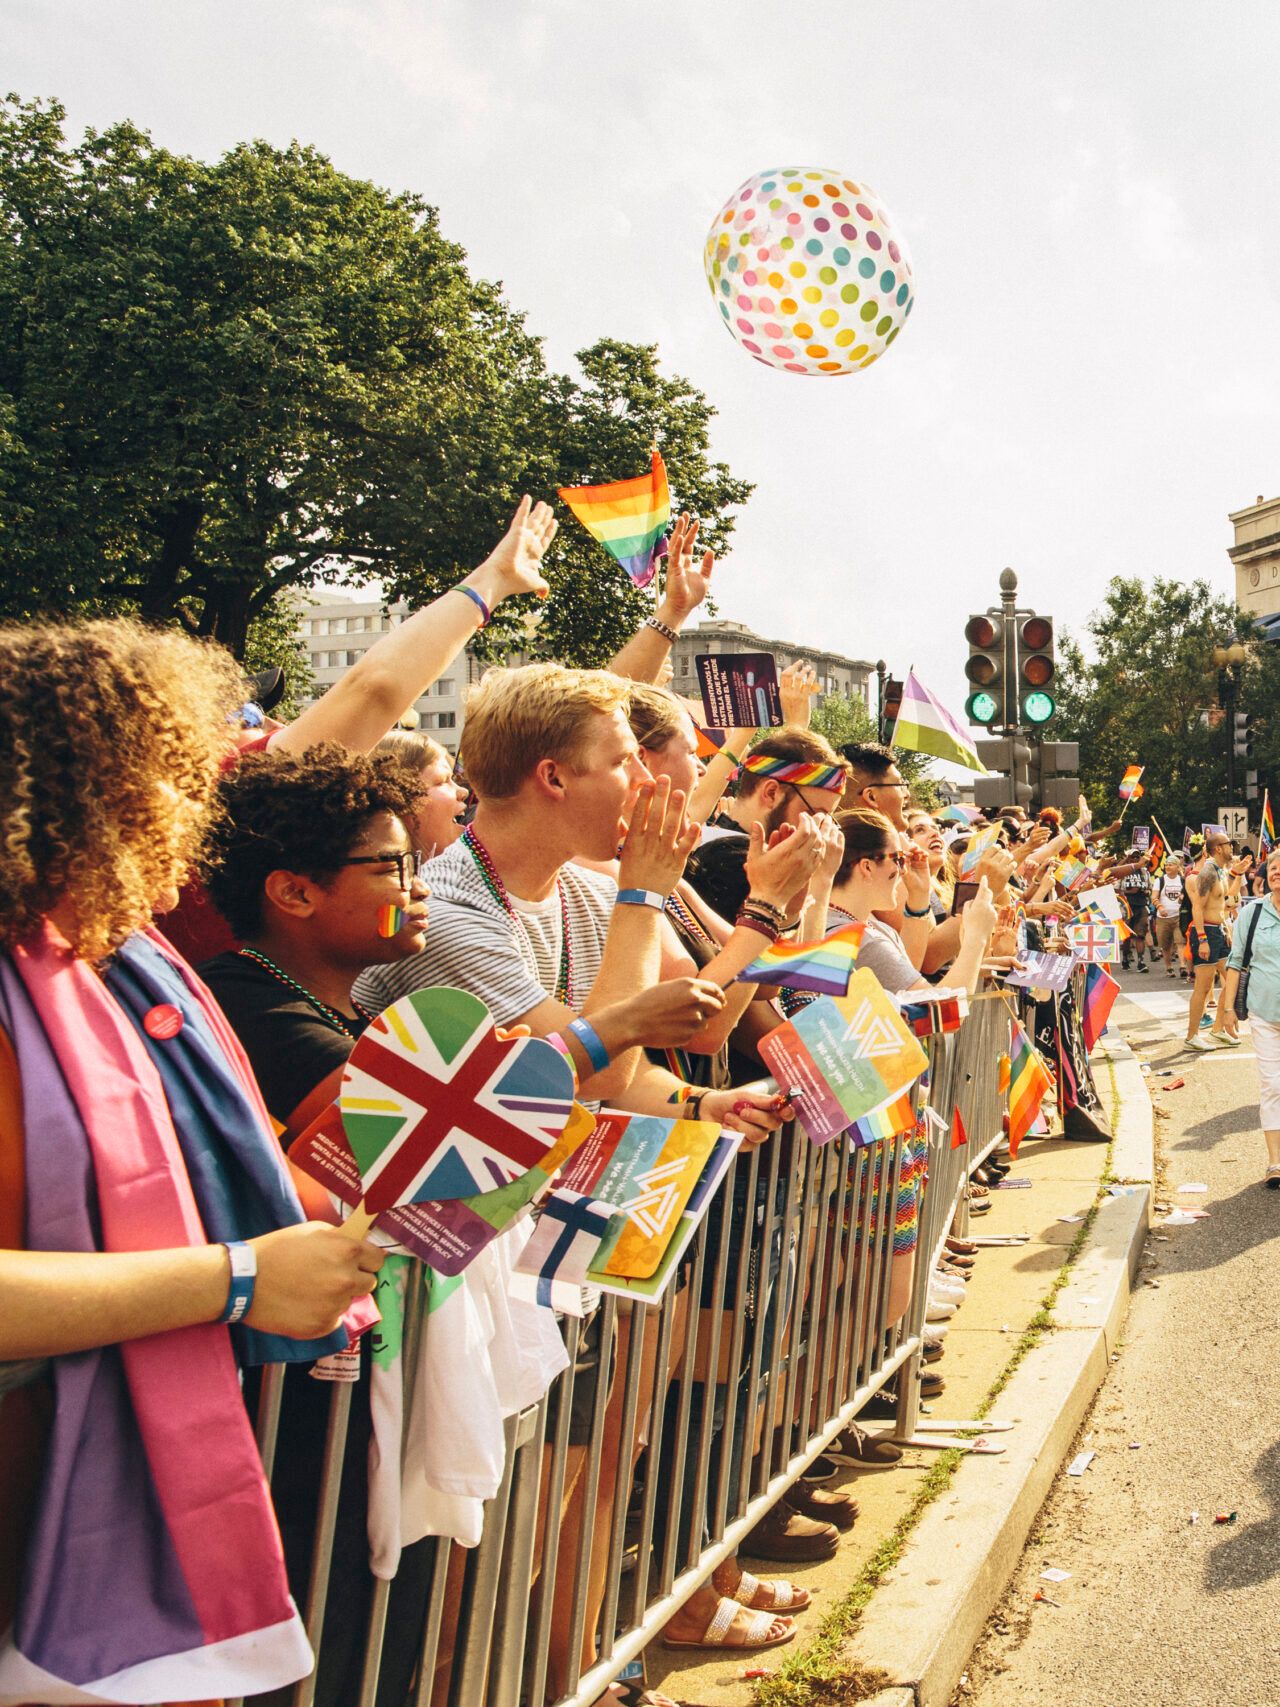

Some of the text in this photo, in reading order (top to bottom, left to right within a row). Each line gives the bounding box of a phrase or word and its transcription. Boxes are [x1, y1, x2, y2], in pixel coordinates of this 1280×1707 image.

[710, 658, 719, 681] PUEDE
[717, 696, 728, 727] PASTILLA
[724, 694, 735, 727] PREVENIR
[442, 1228, 472, 1251] PHARMACY
[432, 1243, 453, 1260] POLICY
